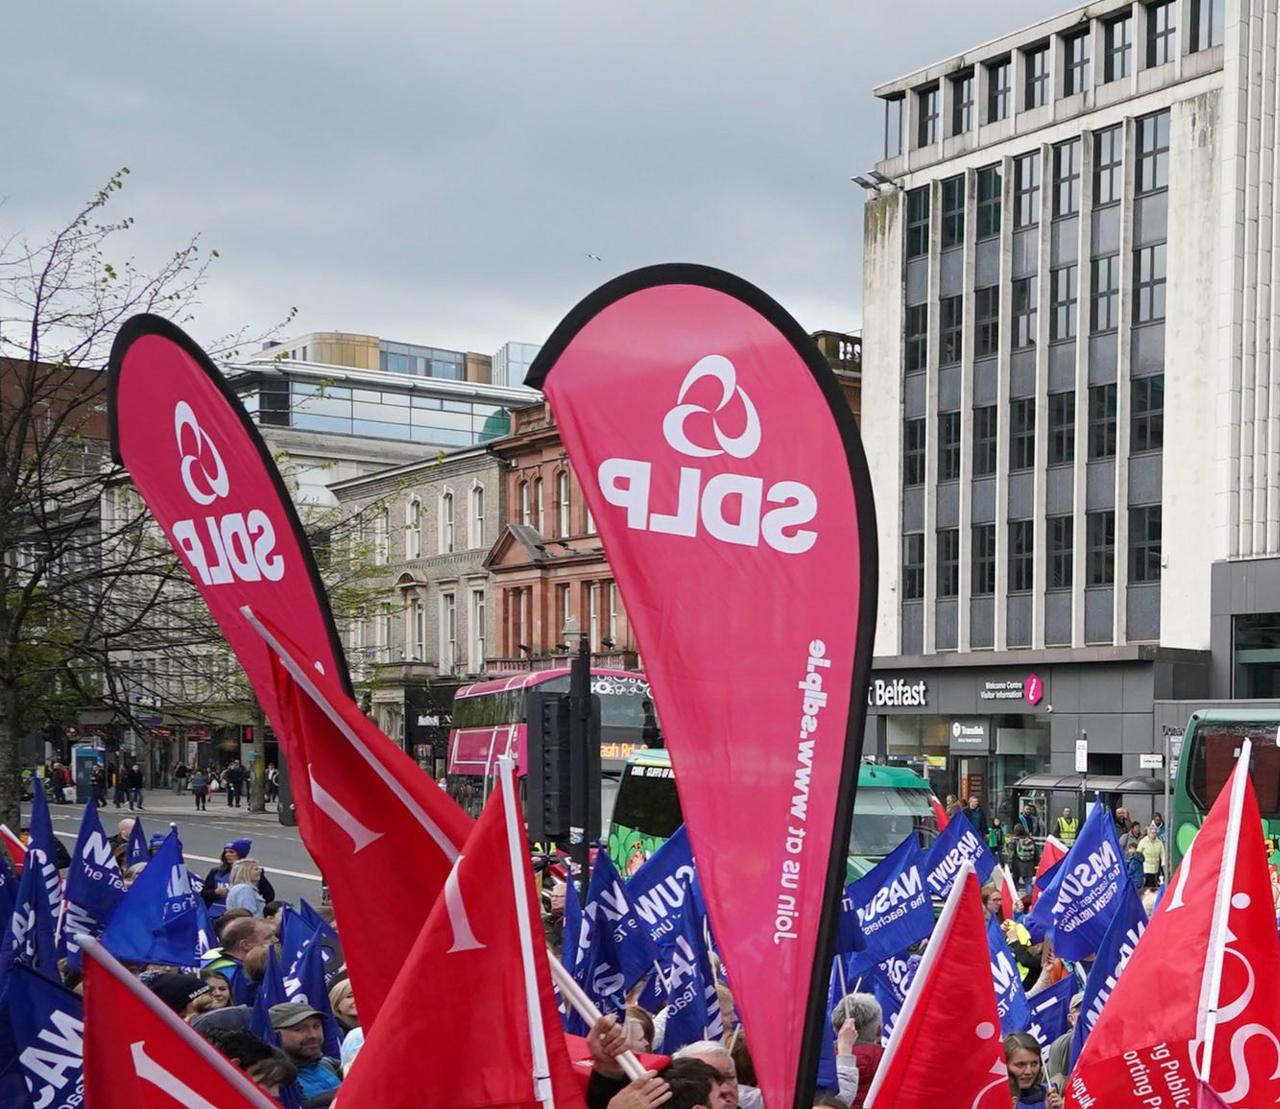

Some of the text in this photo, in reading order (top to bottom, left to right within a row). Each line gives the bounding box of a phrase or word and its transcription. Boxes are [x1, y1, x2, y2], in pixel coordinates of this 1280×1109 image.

[875, 679, 927, 707] Belfast
[1122, 1050, 1153, 1098] orting
[1164, 1060, 1189, 1109] Public
